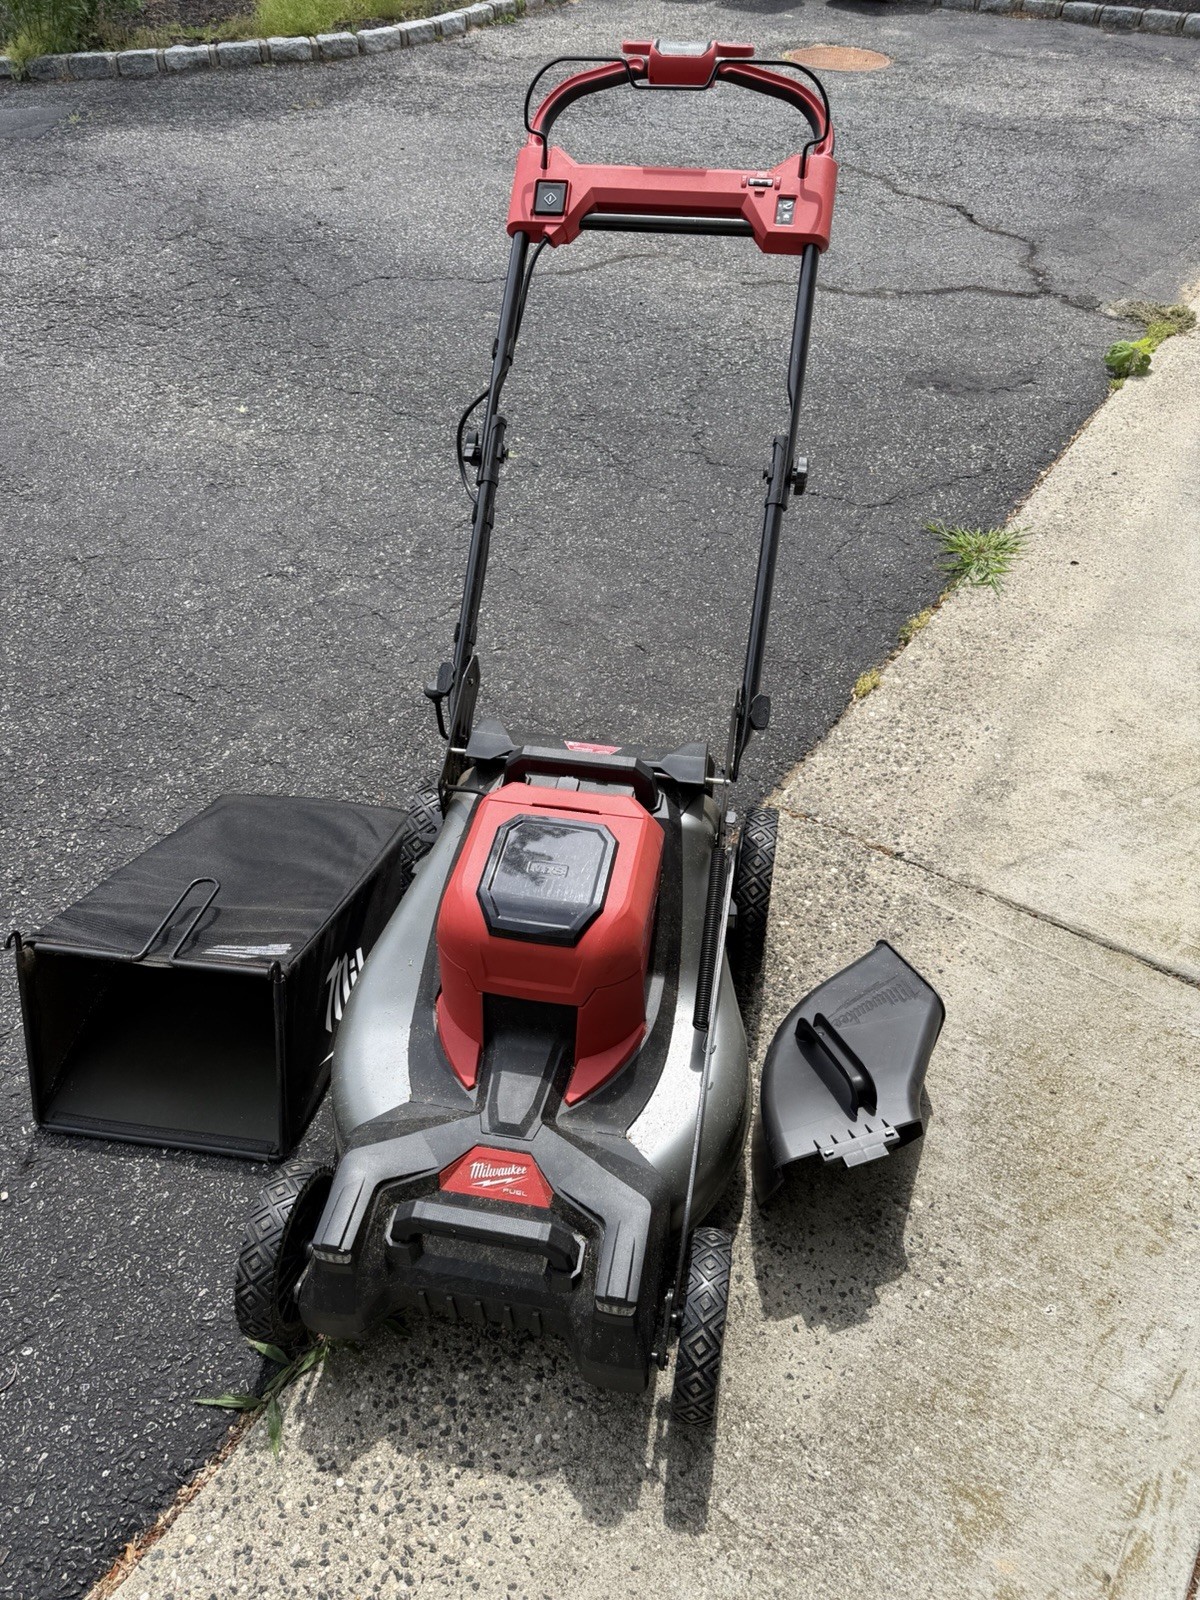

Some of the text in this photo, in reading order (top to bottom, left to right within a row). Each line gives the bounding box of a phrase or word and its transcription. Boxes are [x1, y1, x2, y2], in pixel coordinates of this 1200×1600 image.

[832, 980, 921, 1027] Milwaukee
[470, 1161, 527, 1179] Milwaukee
[502, 1188, 527, 1197] FUEL
